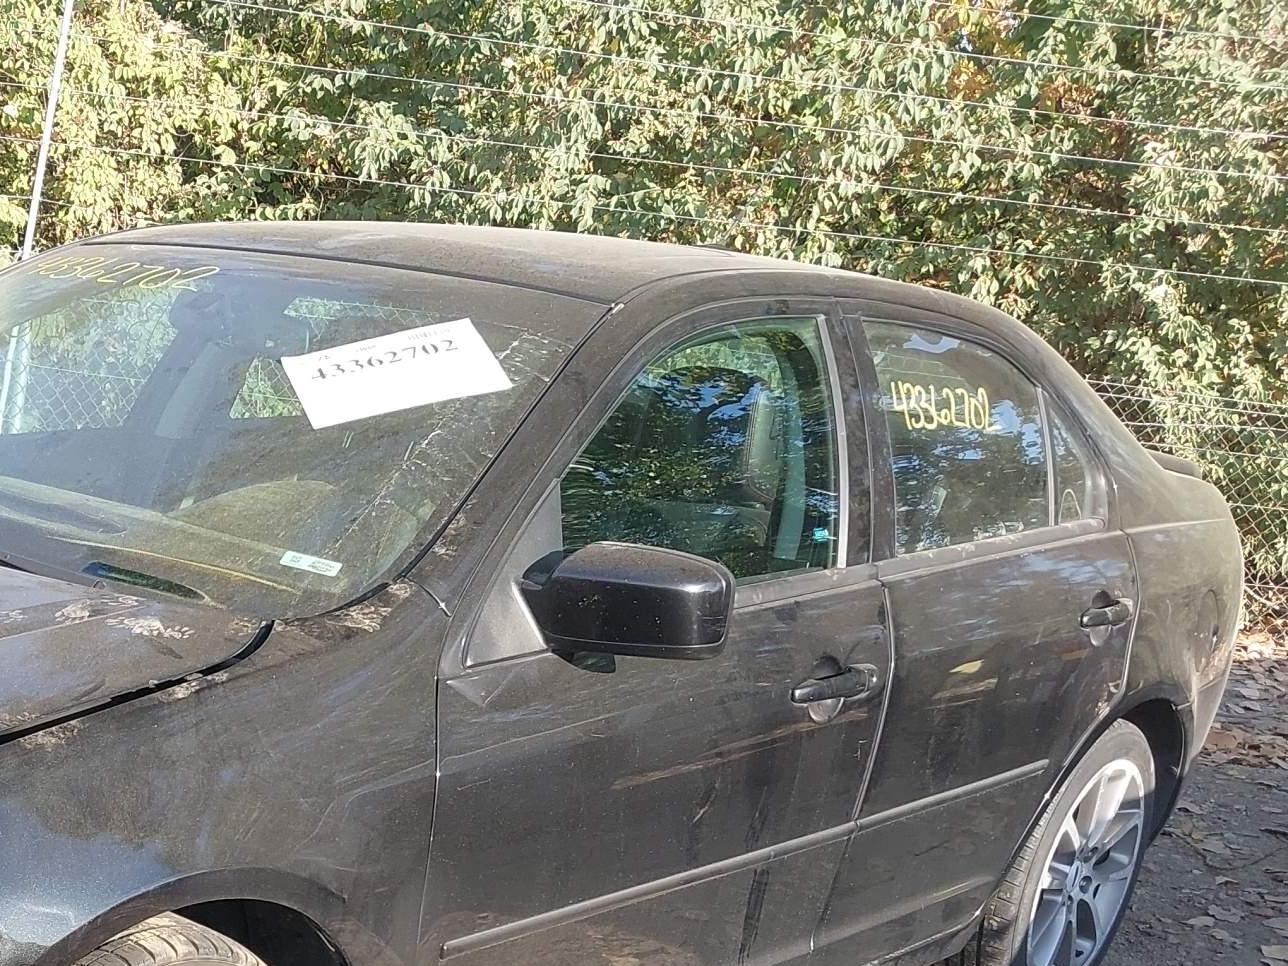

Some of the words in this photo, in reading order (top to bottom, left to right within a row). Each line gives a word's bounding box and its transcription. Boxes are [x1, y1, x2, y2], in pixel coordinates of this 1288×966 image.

[28, 256, 220, 292] 43362702
[311, 338, 459, 380] 43362702
[890, 380, 1002, 433] 43362702
